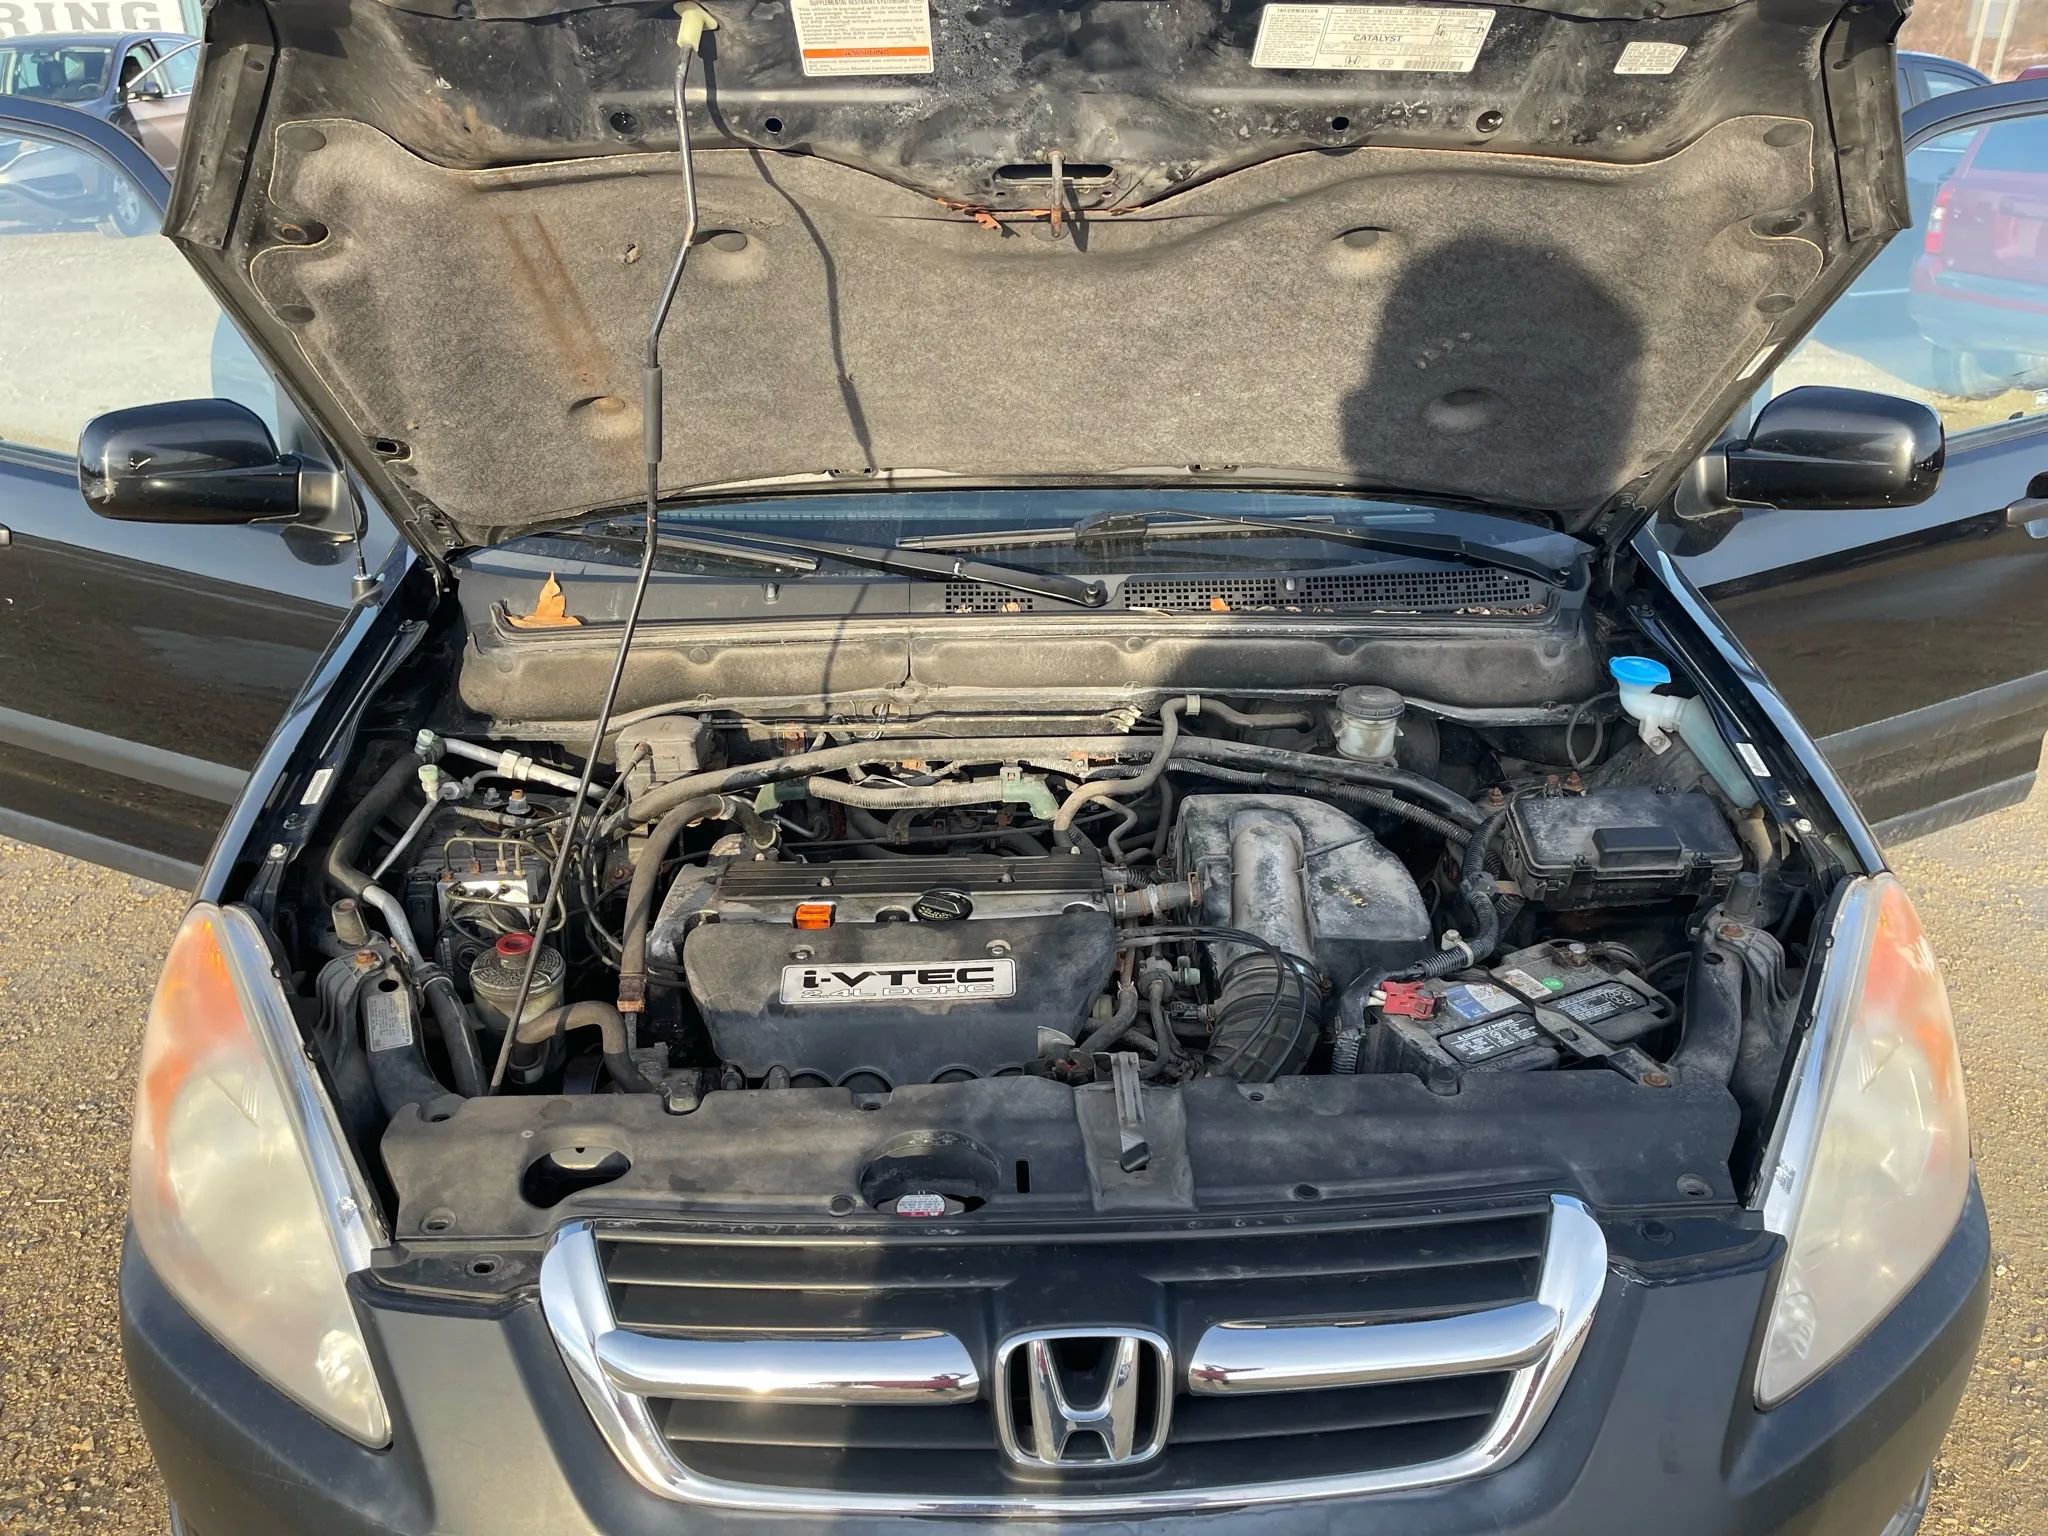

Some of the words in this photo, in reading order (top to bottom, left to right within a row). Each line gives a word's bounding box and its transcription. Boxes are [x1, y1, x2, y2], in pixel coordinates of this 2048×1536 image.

[1353, 34, 1403, 43] CATALYST
[803, 966, 995, 989] i-VTEC
[801, 988, 877, 999] 2.4L
[882, 984, 995, 996] DOHC
